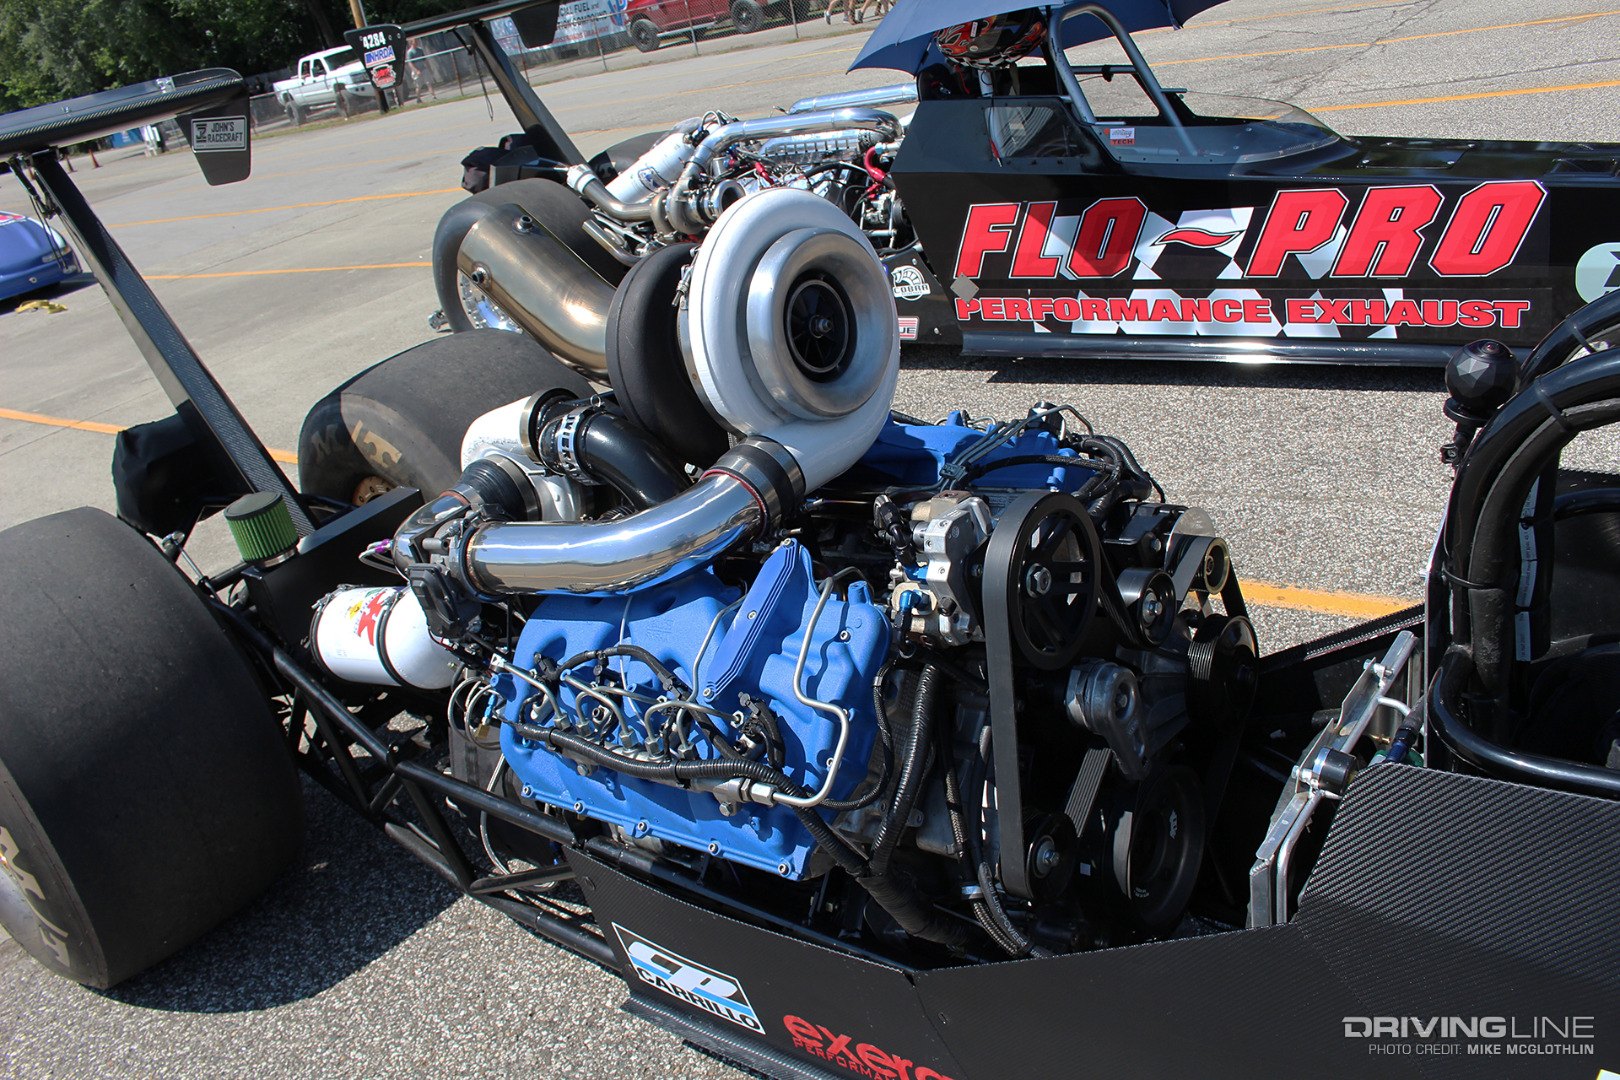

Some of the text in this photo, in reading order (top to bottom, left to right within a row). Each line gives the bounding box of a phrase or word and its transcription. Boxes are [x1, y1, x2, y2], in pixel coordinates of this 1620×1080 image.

[574, 2, 590, 13] FUEL
[362, 31, 386, 49] 4284
[367, 45, 394, 63] NHRDA
[211, 121, 234, 132] JOHN'S
[207, 132, 243, 143] RACECRAFT
[953, 197, 1148, 280] FLO
[1243, 180, 1548, 279] PRO
[893, 284, 928, 294] COBRA
[956, 297, 1530, 328] PERFORMANCE EXHAUST
[637, 967, 761, 1030] CARRILLO
[791, 1036, 897, 1080] PERFORMA
